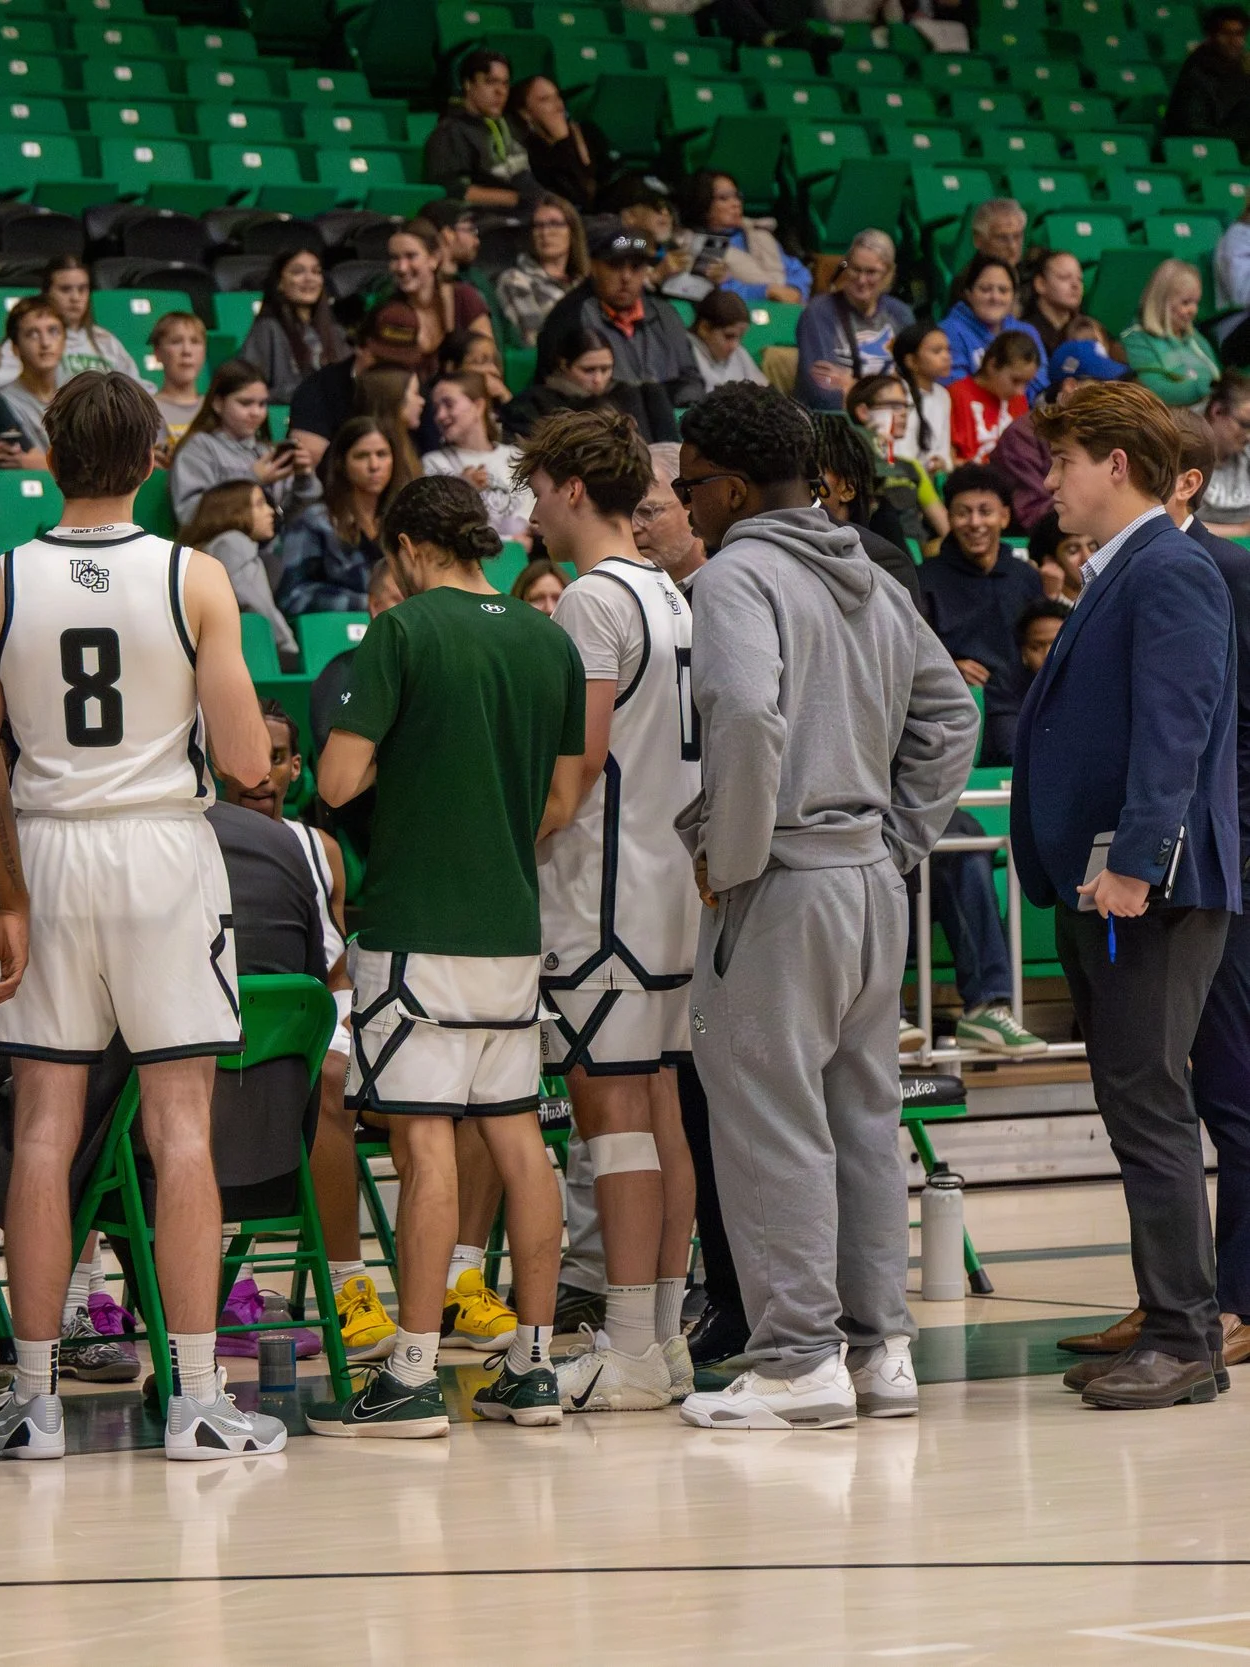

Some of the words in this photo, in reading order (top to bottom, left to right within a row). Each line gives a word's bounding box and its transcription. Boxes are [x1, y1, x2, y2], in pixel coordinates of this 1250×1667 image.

[92, 524, 115, 533] PRO
[59, 627, 124, 748] 8
[538, 1383, 548, 1392] 24
